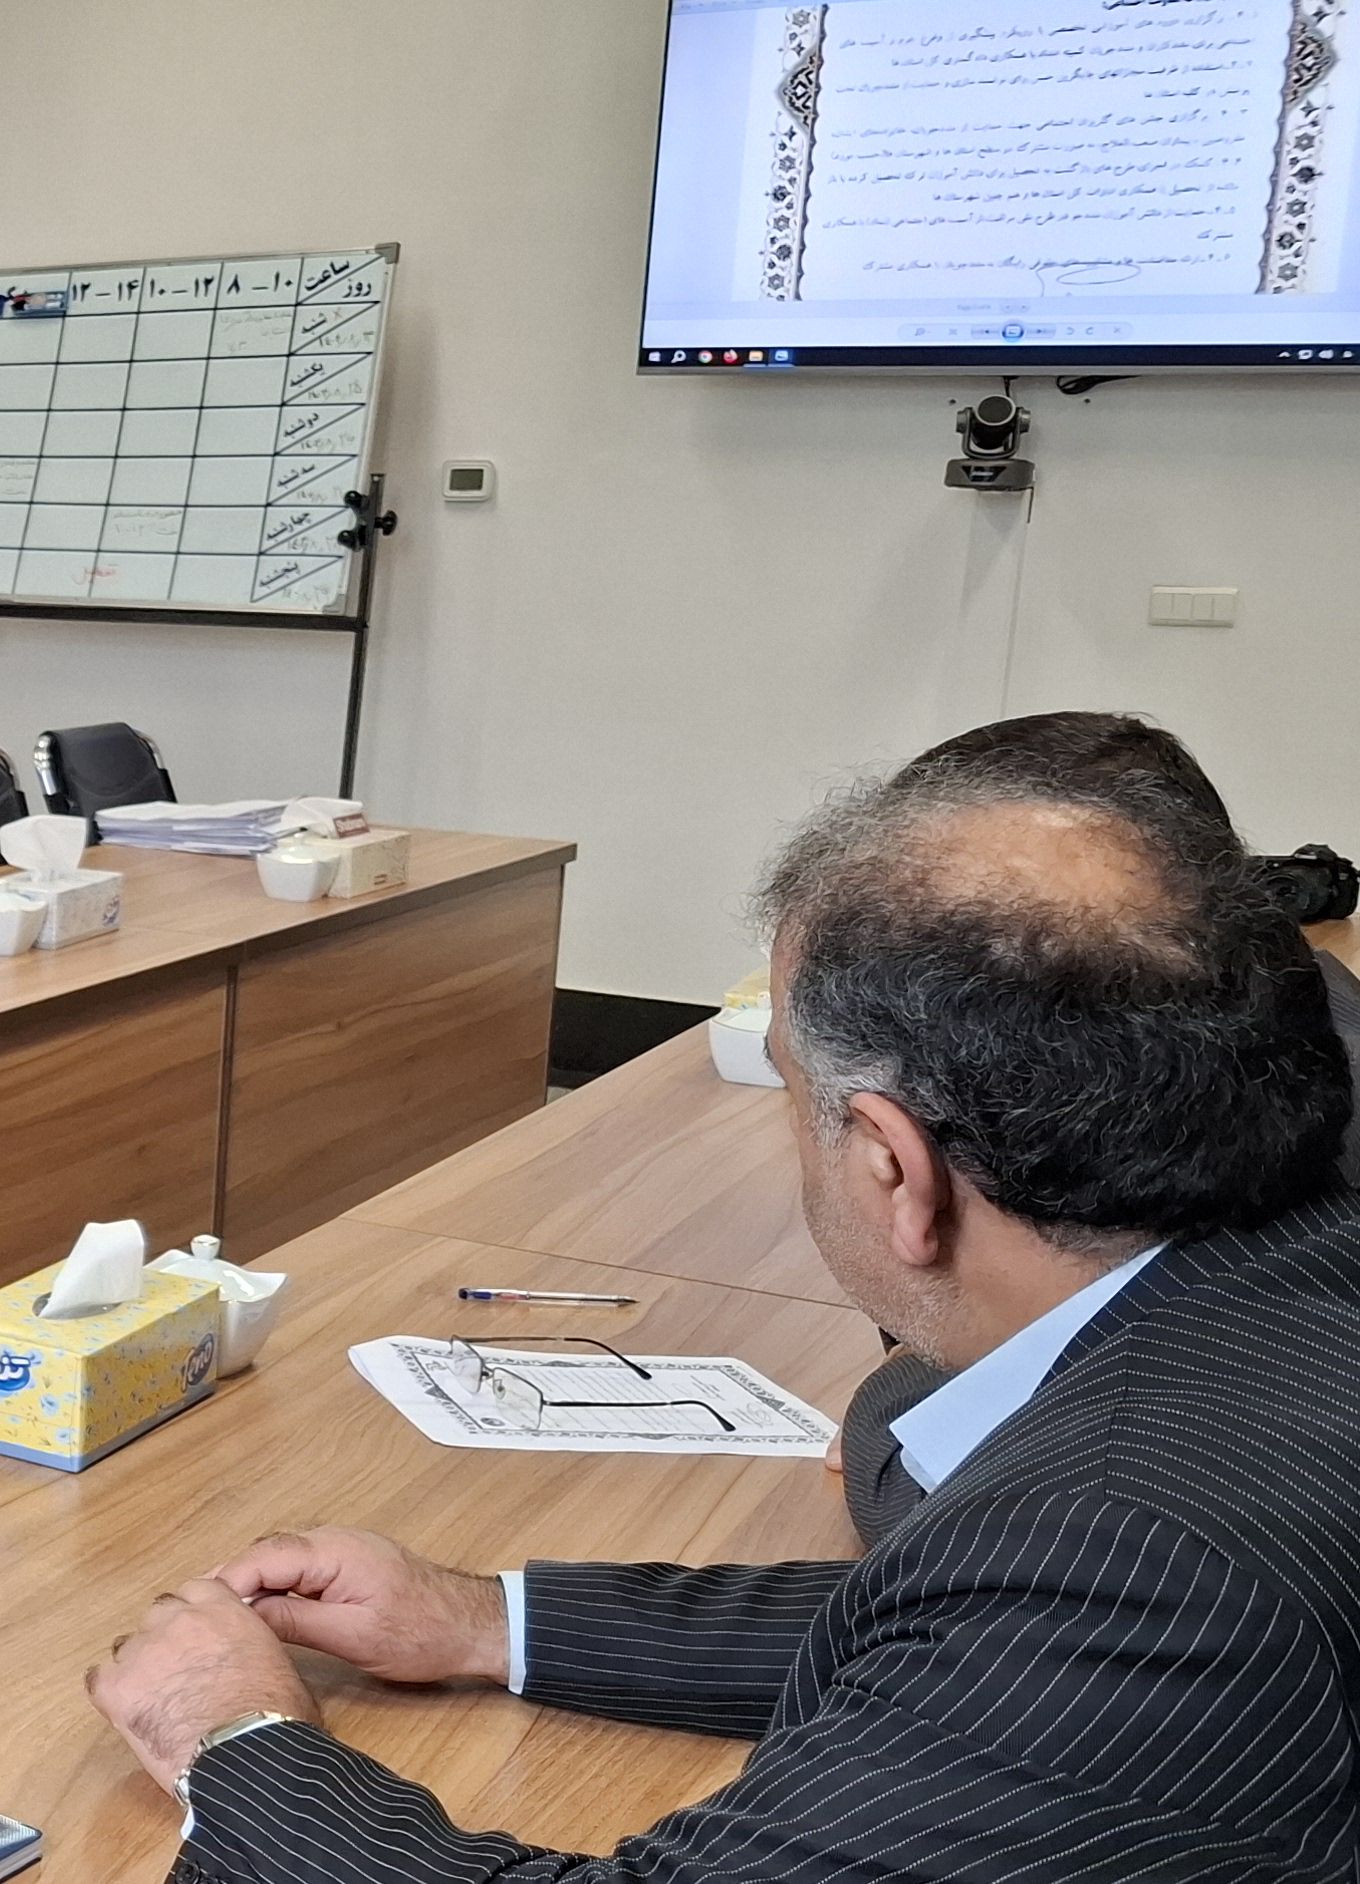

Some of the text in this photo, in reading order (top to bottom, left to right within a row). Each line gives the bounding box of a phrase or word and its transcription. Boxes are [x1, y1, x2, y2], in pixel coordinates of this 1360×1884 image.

[148, 279, 166, 300] ۱۰
[192, 275, 215, 298] ۱۲
[226, 273, 241, 295] ۸
[273, 271, 294, 293] ۱۰
[304, 260, 349, 291] ساعت
[343, 277, 372, 298] روز
[71, 282, 92, 302] ۱۲
[117, 279, 140, 302] ۱۴
[301, 311, 327, 335] شنبه
[290, 362, 324, 389] یکشنبه
